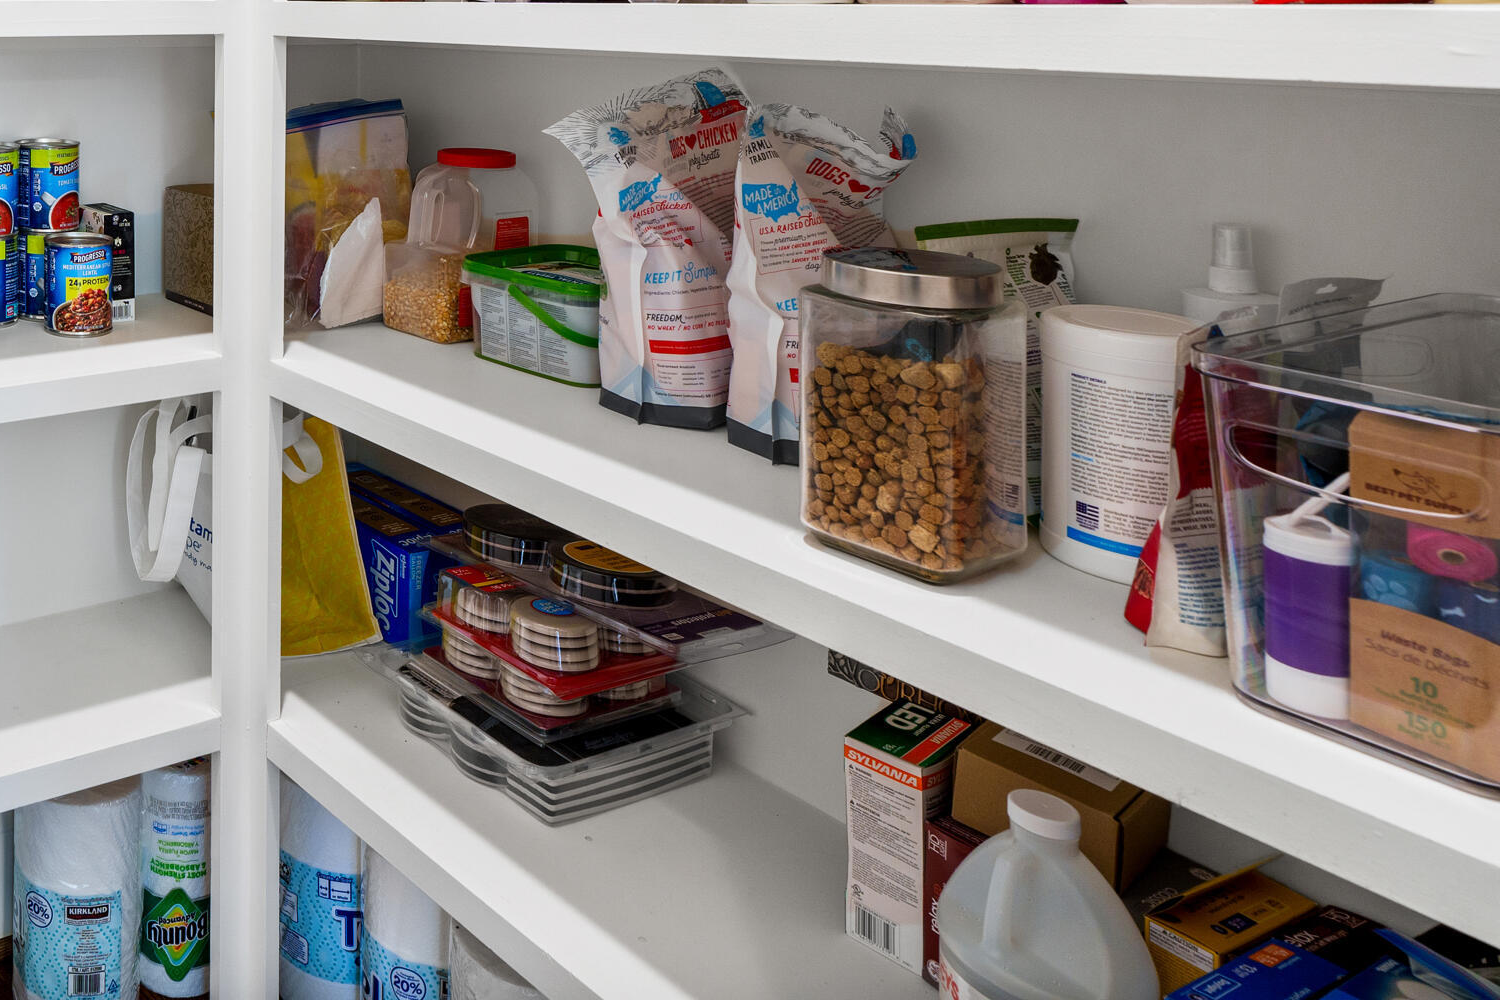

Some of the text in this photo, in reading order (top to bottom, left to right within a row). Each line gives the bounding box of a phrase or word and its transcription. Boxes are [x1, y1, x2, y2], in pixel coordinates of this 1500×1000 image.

[699, 121, 738, 150] CHICKEN
[806, 157, 850, 185] DOGS
[745, 185, 773, 205] MADE
[757, 191, 798, 215] AMERICA
[777, 222, 804, 233] RAISED
[73, 251, 105, 262] PROGRESSO
[82, 277, 109, 286] PROTEIN
[645, 270, 682, 284] KEEP IT
[646, 313, 685, 324] FREEDOM
[1364, 482, 1420, 504] BEST PET
[372, 549, 396, 632] Ziploc
[1365, 638, 1398, 658] Sacs
[1380, 629, 1471, 668] Waste Bags
[1410, 677, 1439, 699] 10
[885, 702, 936, 731] LED
[1403, 711, 1447, 739] 150
[931, 720, 964, 745] SYLVANIA
[847, 750, 918, 787] SYLVANIA
[28, 900, 50, 920] 20%
[69, 907, 108, 915] KIRKLAND
[148, 912, 209, 948] Bounty
[392, 975, 423, 995] 20%
